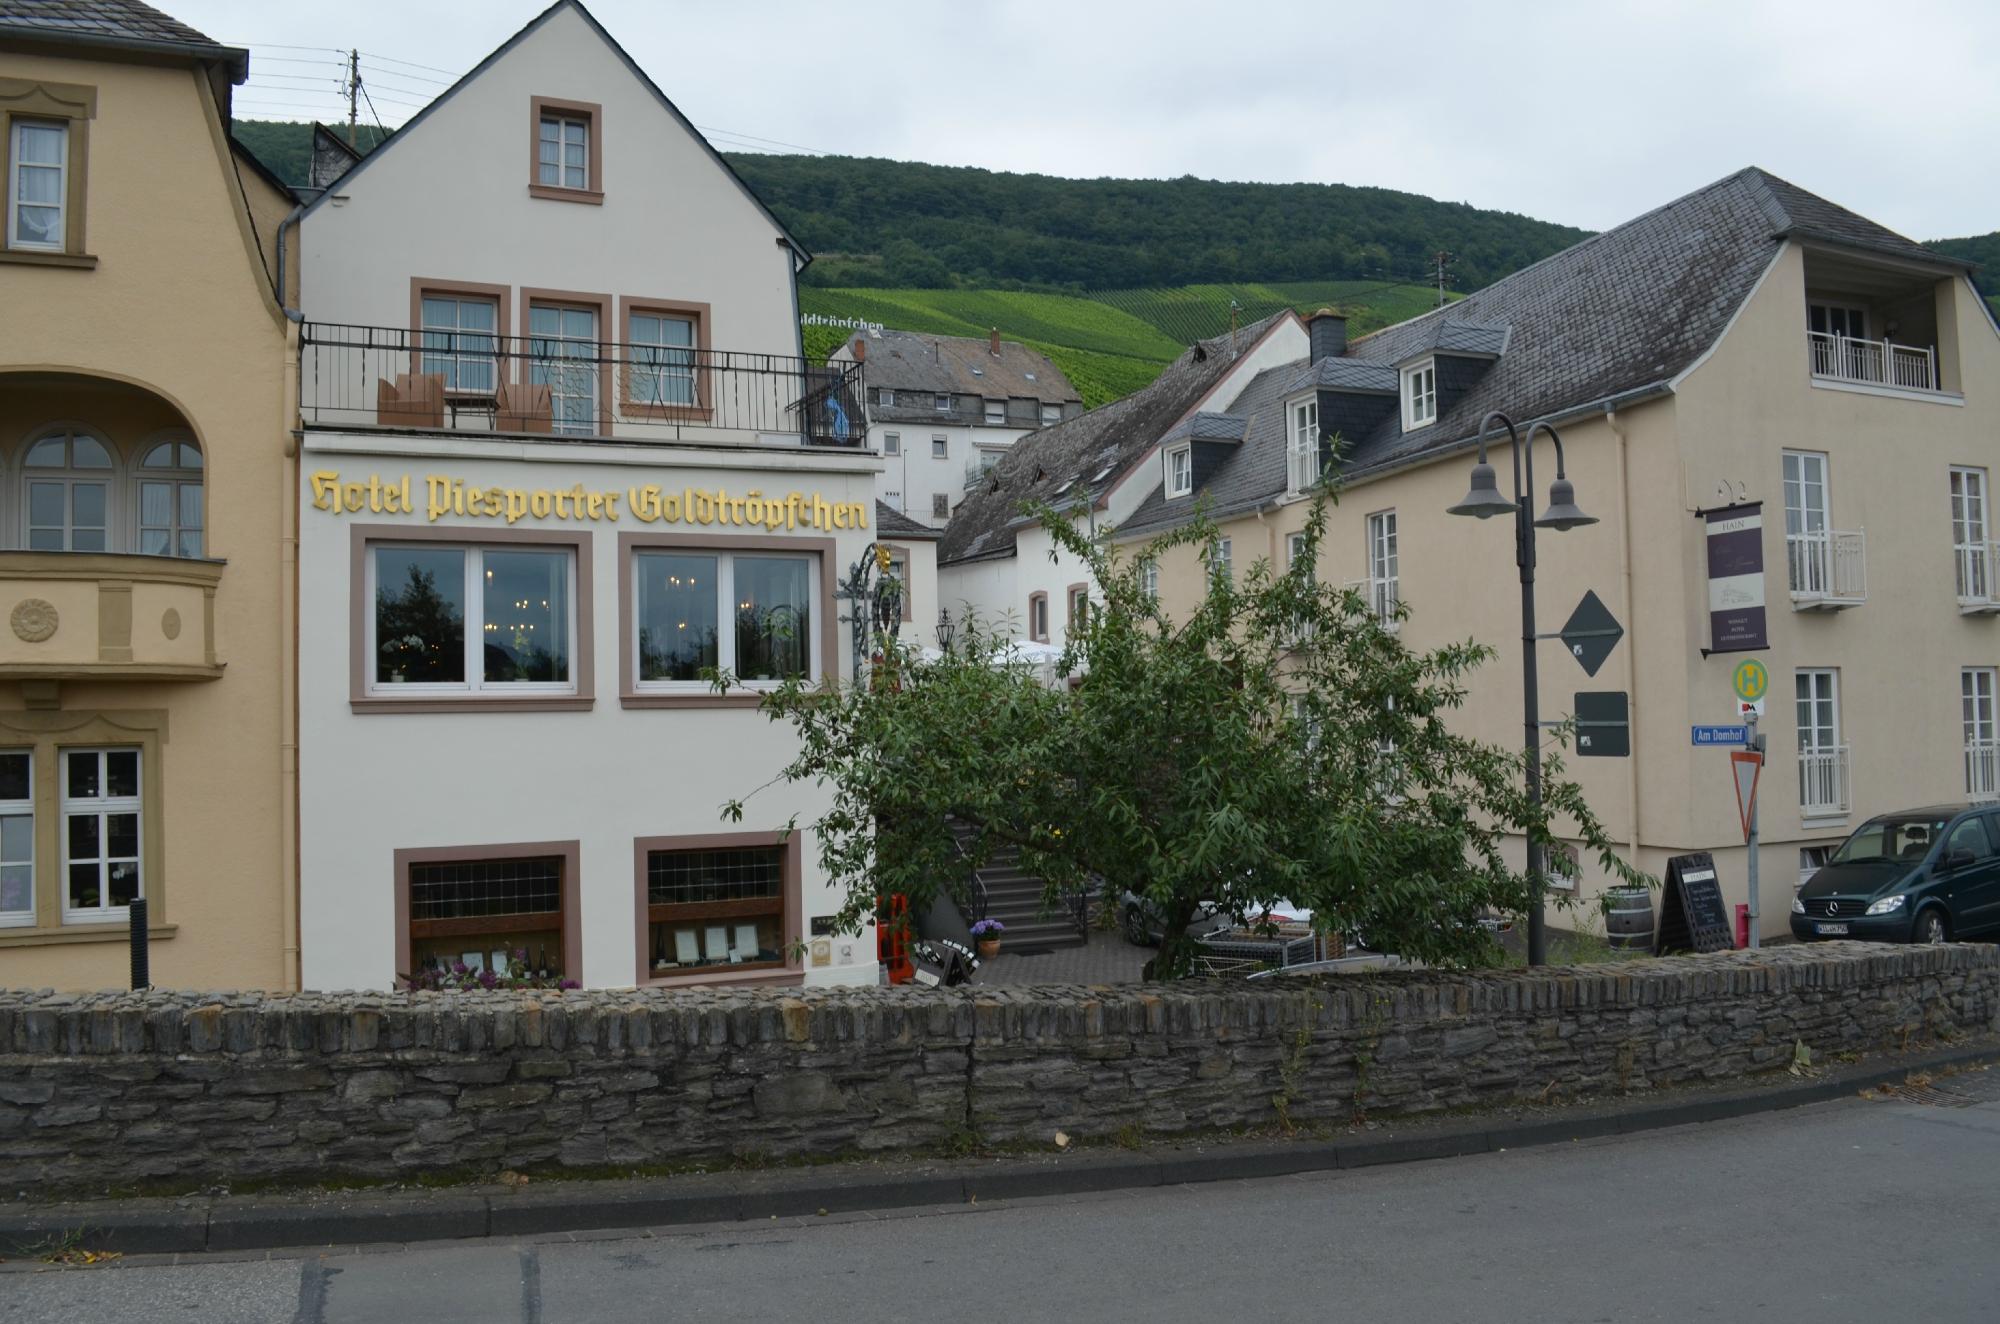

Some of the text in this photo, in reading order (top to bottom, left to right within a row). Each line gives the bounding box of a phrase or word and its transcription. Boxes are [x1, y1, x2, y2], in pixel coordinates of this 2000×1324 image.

[309, 470, 868, 532] Hotel Piesporter Goldtröpfchen
[1722, 519, 1745, 531] HAIN
[1697, 728, 1743, 741] Am Domhof
